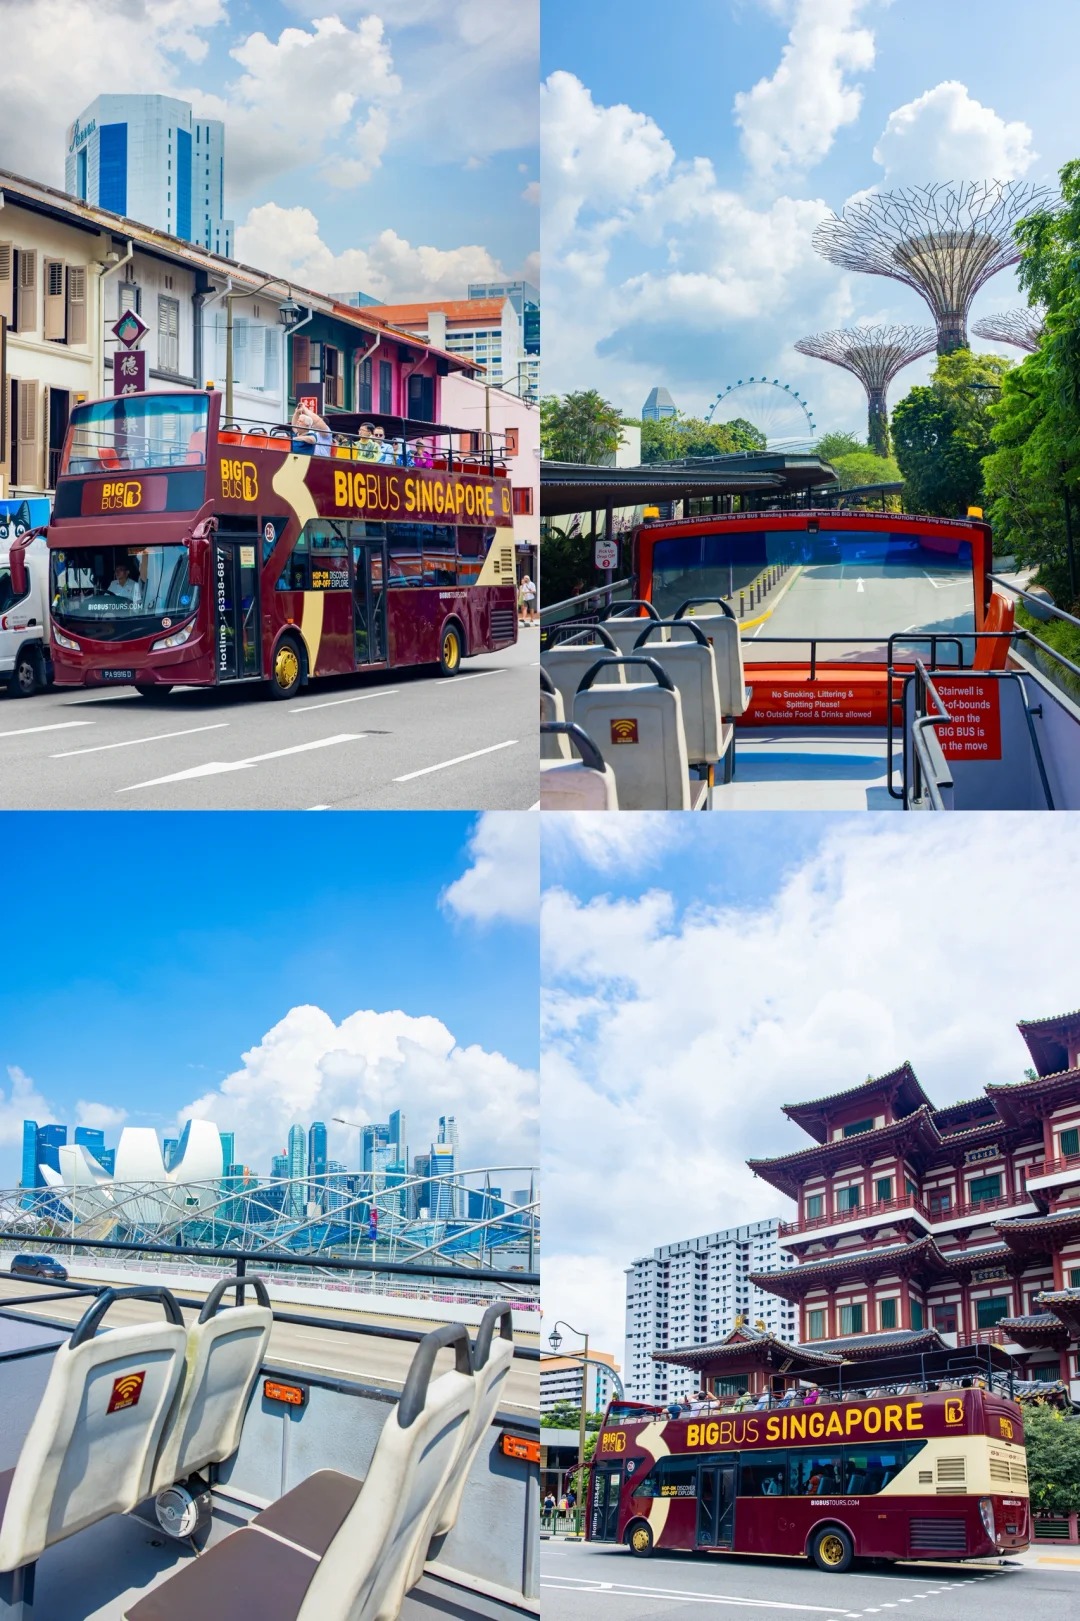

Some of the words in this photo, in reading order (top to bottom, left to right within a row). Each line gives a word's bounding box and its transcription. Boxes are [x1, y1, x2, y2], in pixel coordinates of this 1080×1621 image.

[220, 458, 242, 481] BIG
[102, 482, 125, 498] BIG
[221, 479, 242, 499] BUS
[405, 478, 495, 517] SINGAPORE
[101, 495, 123, 510] BUS
[950, 520, 973, 528] branches
[216, 546, 226, 612] 6338-6877
[312, 571, 329, 580] HOP-ON
[329, 571, 349, 580] DISCOVER
[312, 579, 331, 588] HOP-OFF
[331, 579, 349, 588] EXPLORE
[87, 603, 143, 611] BIGBUSTOURS.COM
[219, 624, 227, 671] Hotline
[817, 690, 847, 699] Littering
[938, 686, 974, 696] Stairwell
[976, 686, 984, 696] is
[786, 700, 813, 709] Spitting
[931, 700, 991, 709] ot-of-bounds
[766, 710, 794, 718] Outside
[794, 710, 813, 718] Food
[821, 710, 844, 718] Drinks
[845, 710, 872, 718] allowed
[949, 713, 965, 722] hen
[966, 713, 981, 722] the
[938, 726, 955, 737] BIG
[956, 726, 975, 737] BUS
[977, 727, 985, 737] is
[949, 741, 962, 750] the
[964, 742, 988, 750] move
[766, 1402, 924, 1441] SINGAPORE
[603, 1432, 616, 1444] BIG
[601, 1443, 615, 1452] BUS
